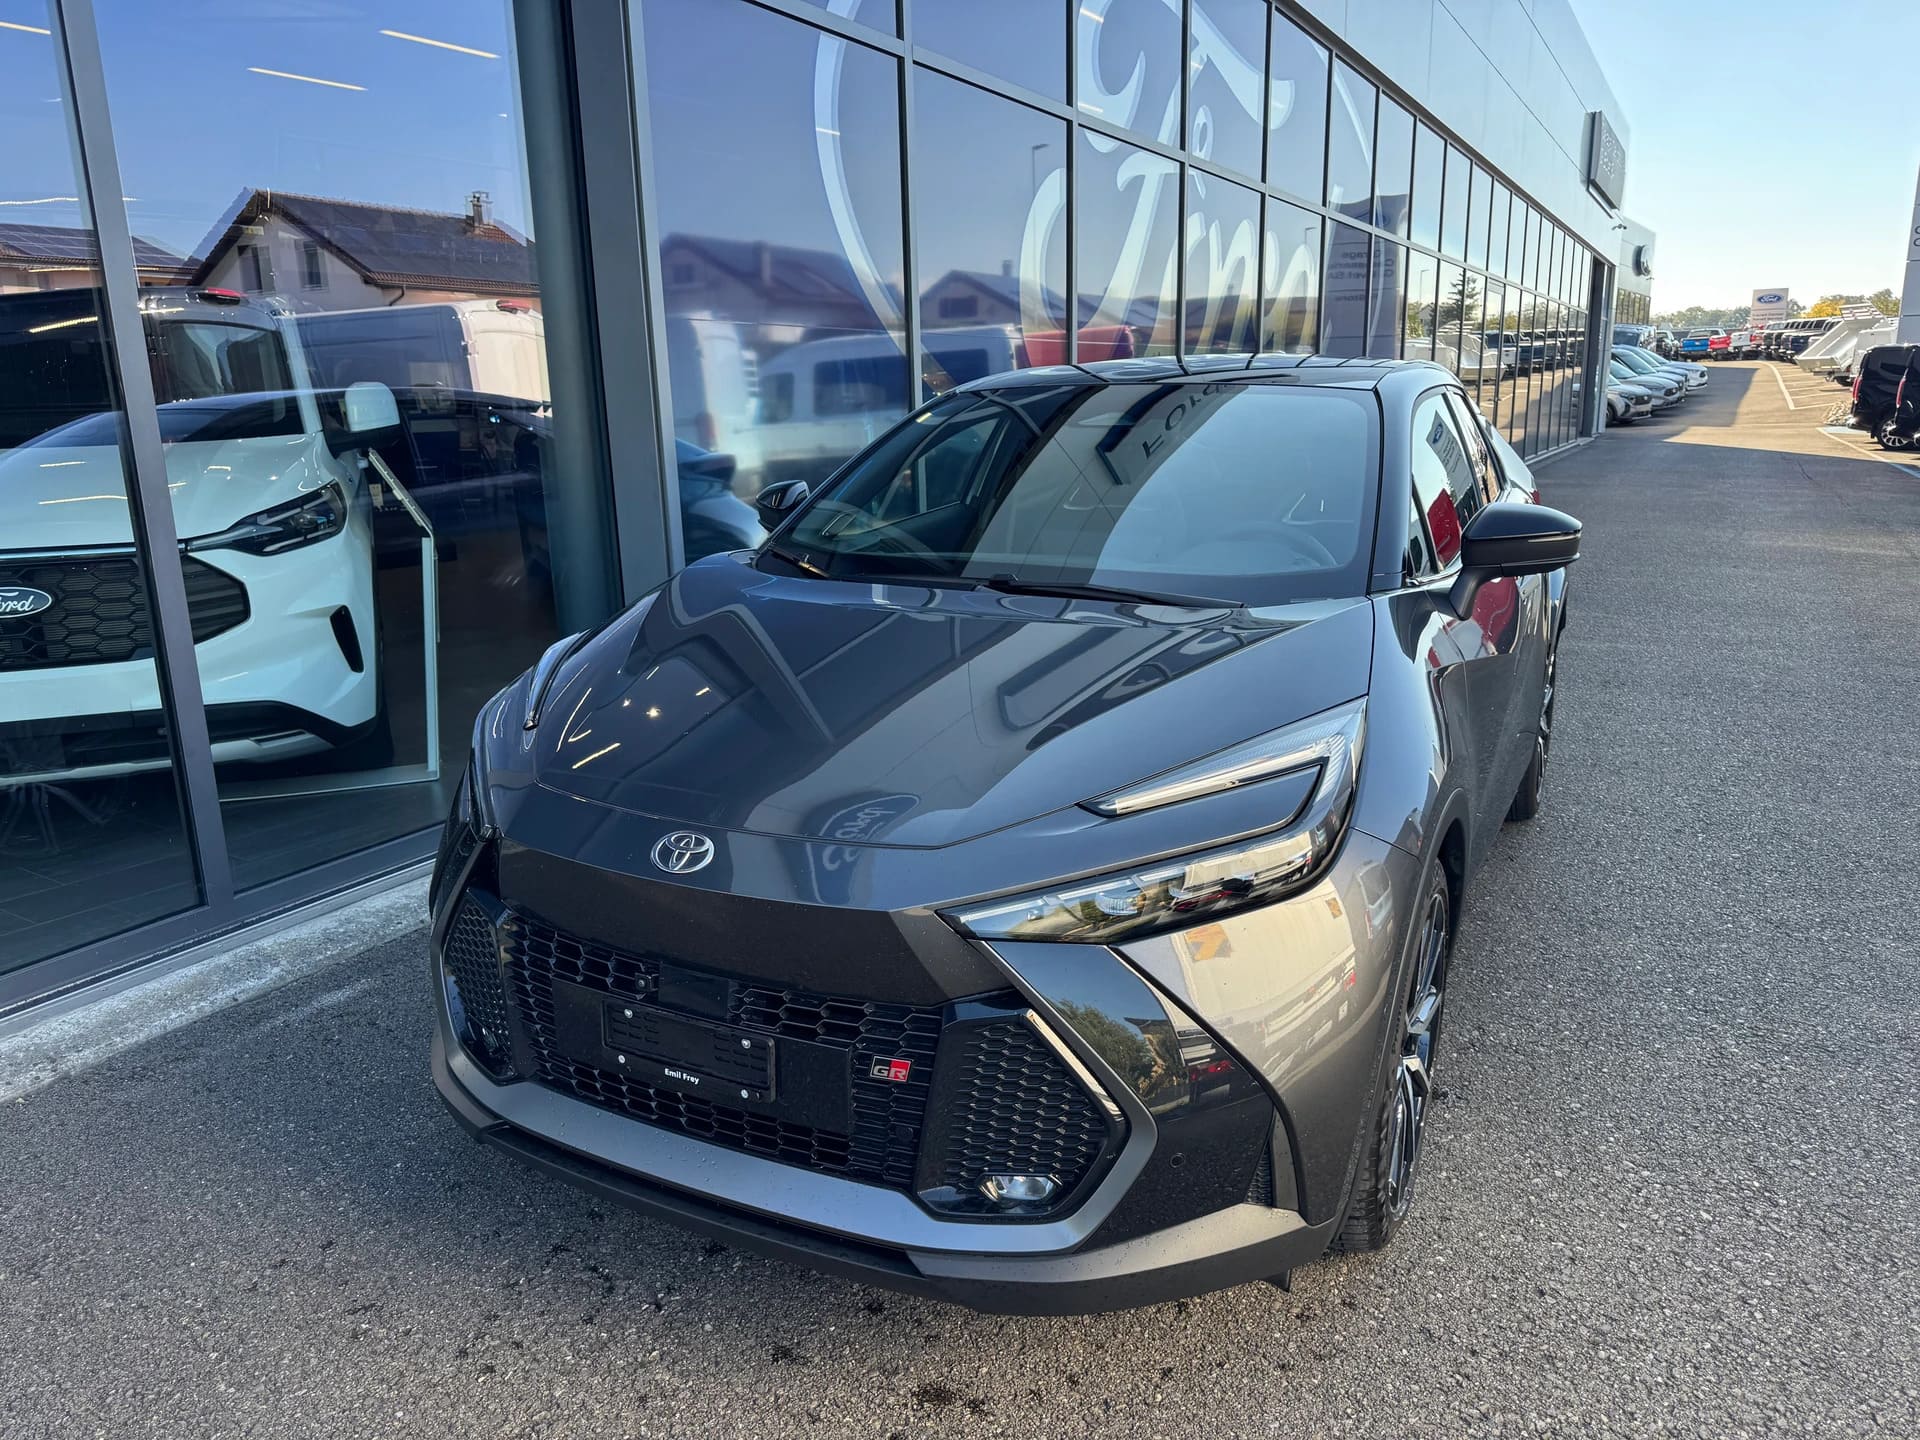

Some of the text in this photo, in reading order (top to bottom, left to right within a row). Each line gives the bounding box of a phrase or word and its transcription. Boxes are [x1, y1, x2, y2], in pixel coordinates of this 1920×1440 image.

[664, 1068, 700, 1085] Emil Frey
[873, 1065, 907, 1080] GR
